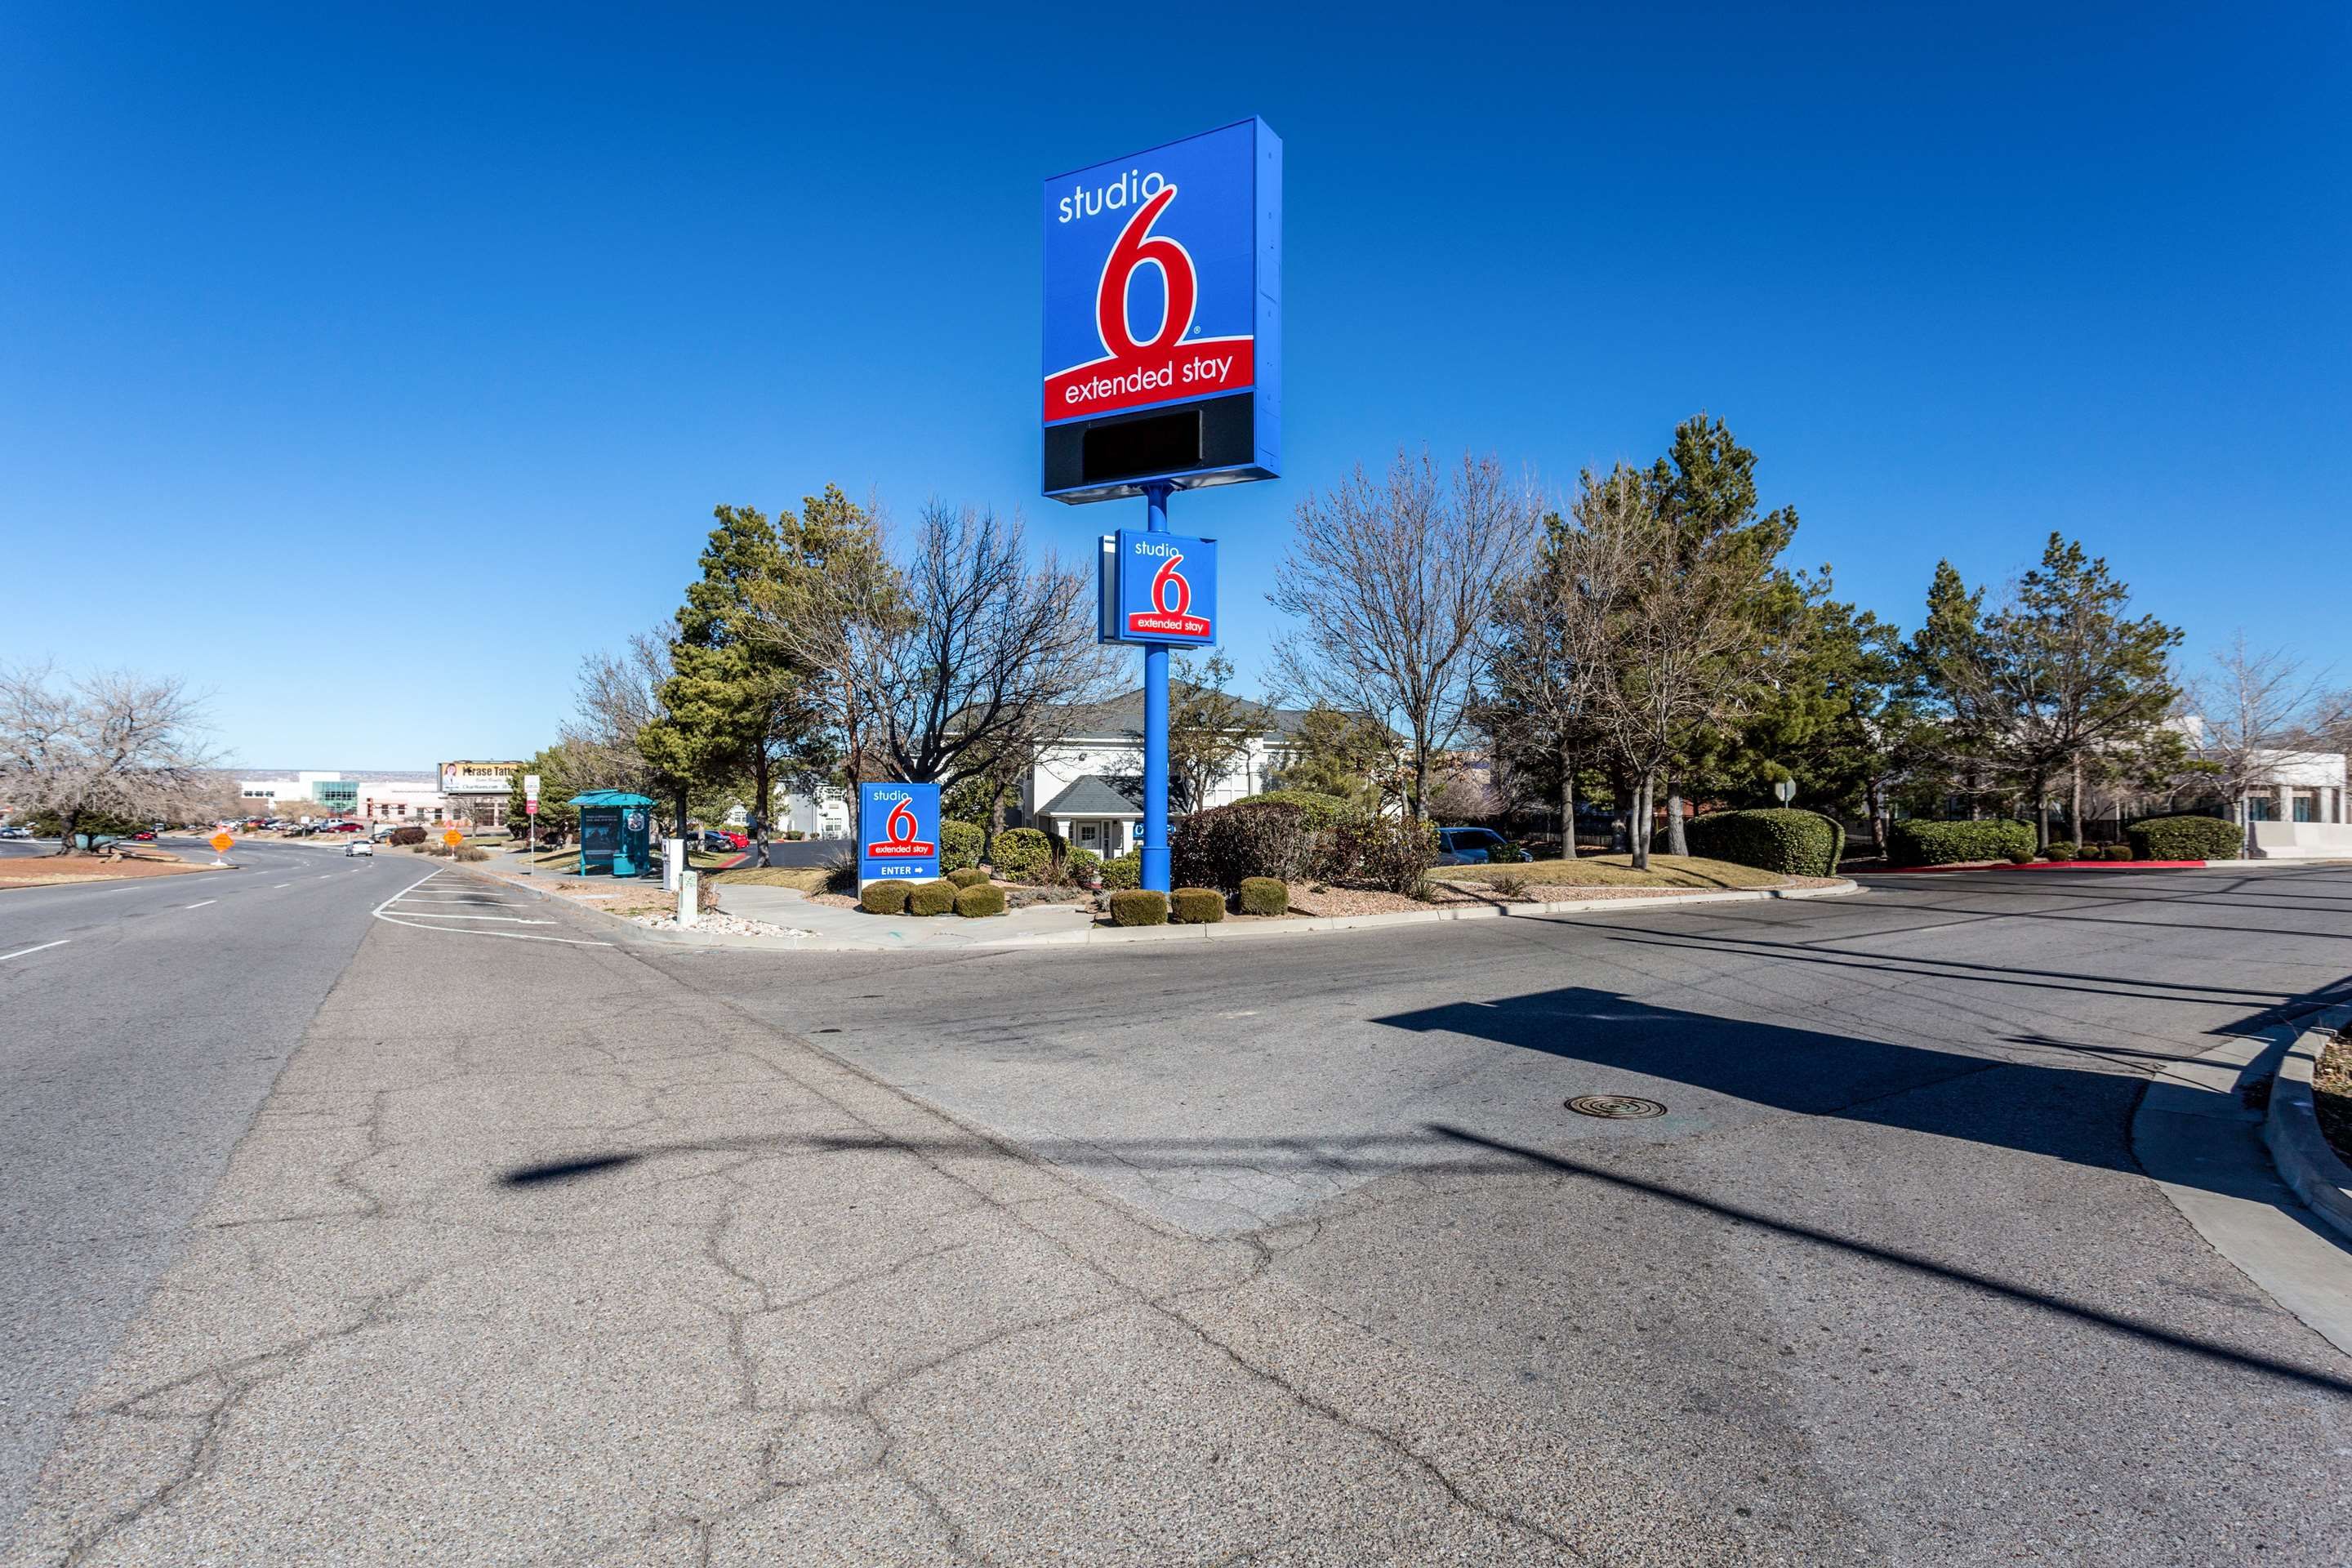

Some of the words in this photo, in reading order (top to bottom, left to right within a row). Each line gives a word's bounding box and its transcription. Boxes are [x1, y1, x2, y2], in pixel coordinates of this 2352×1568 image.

[1058, 168, 1166, 224] studio
[1095, 183, 1198, 358] 6
[1064, 360, 1174, 405] extended
[1181, 355, 1233, 384] stay
[1135, 541, 1179, 557] studio
[1151, 555, 1192, 616] 6
[1138, 618, 1182, 630] extended
[1185, 622, 1204, 634] stay
[873, 790, 909, 801] studio
[886, 797, 919, 844] 6
[875, 845, 911, 853] extended
[913, 845, 929, 854] stay
[881, 866, 911, 875] ENTER
